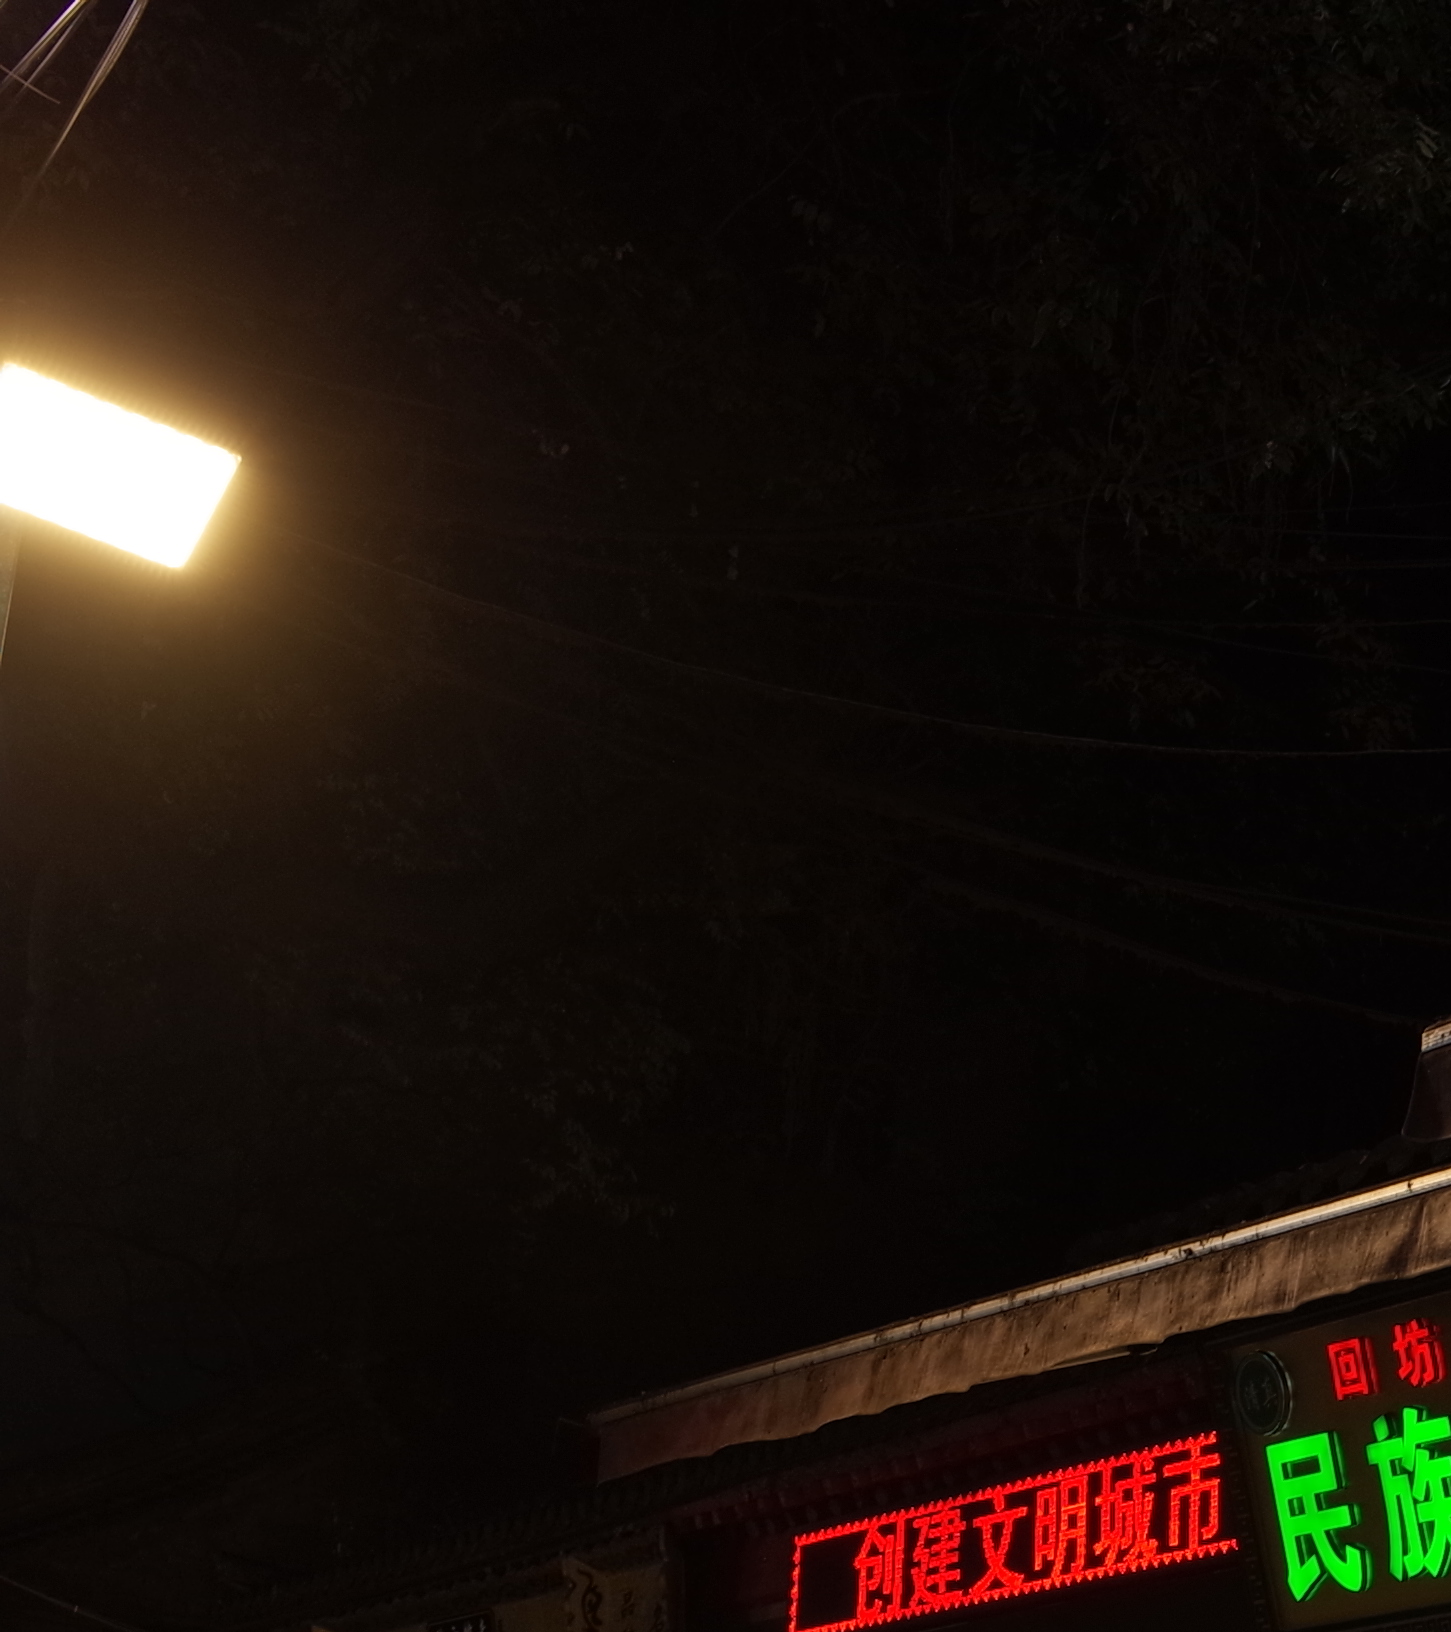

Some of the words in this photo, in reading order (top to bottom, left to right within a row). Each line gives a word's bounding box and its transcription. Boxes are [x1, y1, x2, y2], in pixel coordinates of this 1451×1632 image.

[853, 1436, 1224, 1624] 创建文明城市
